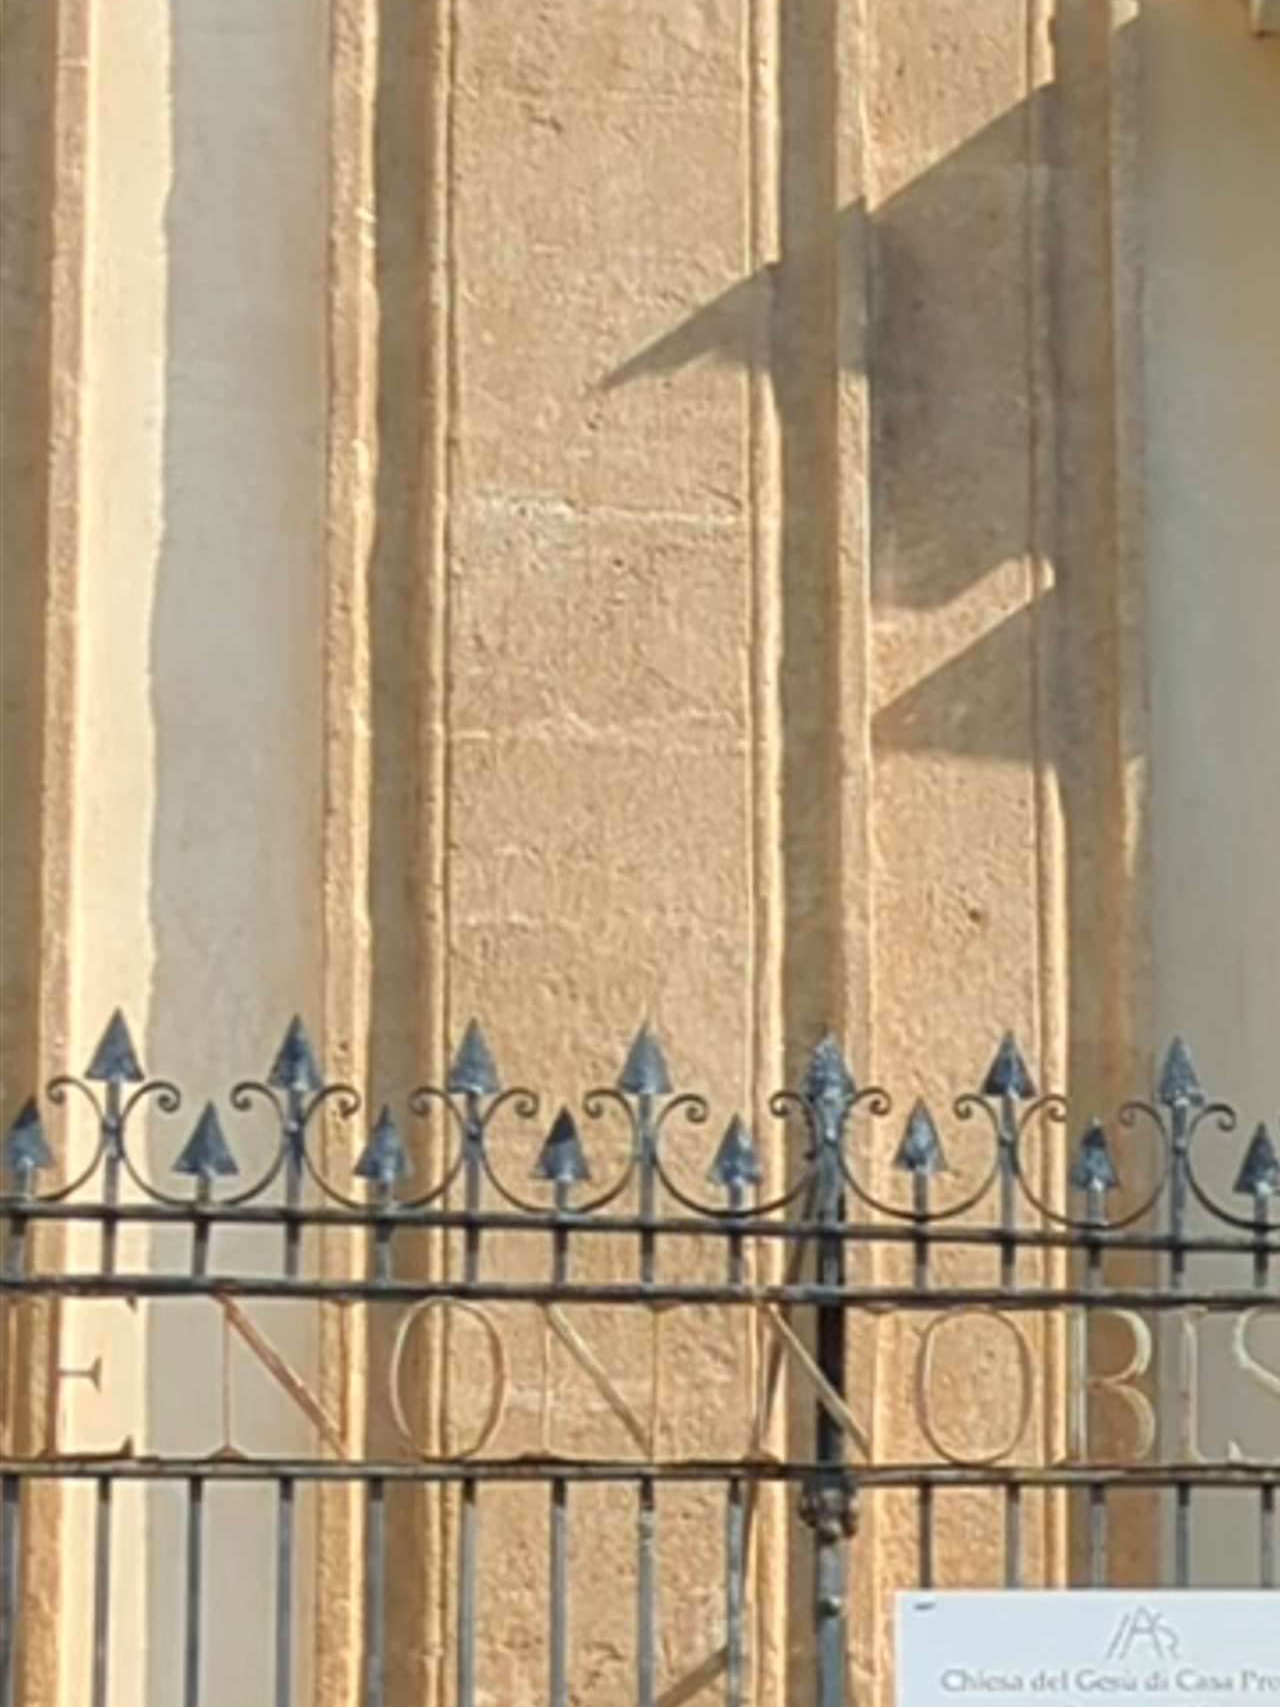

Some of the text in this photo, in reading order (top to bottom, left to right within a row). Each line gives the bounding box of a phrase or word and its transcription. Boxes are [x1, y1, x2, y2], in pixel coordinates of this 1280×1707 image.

[940, 1668, 1024, 1692] Chiesa
[1030, 1668, 1069, 1692] del
[1144, 1669, 1169, 1692] di
[1175, 1668, 1233, 1692] Casa
